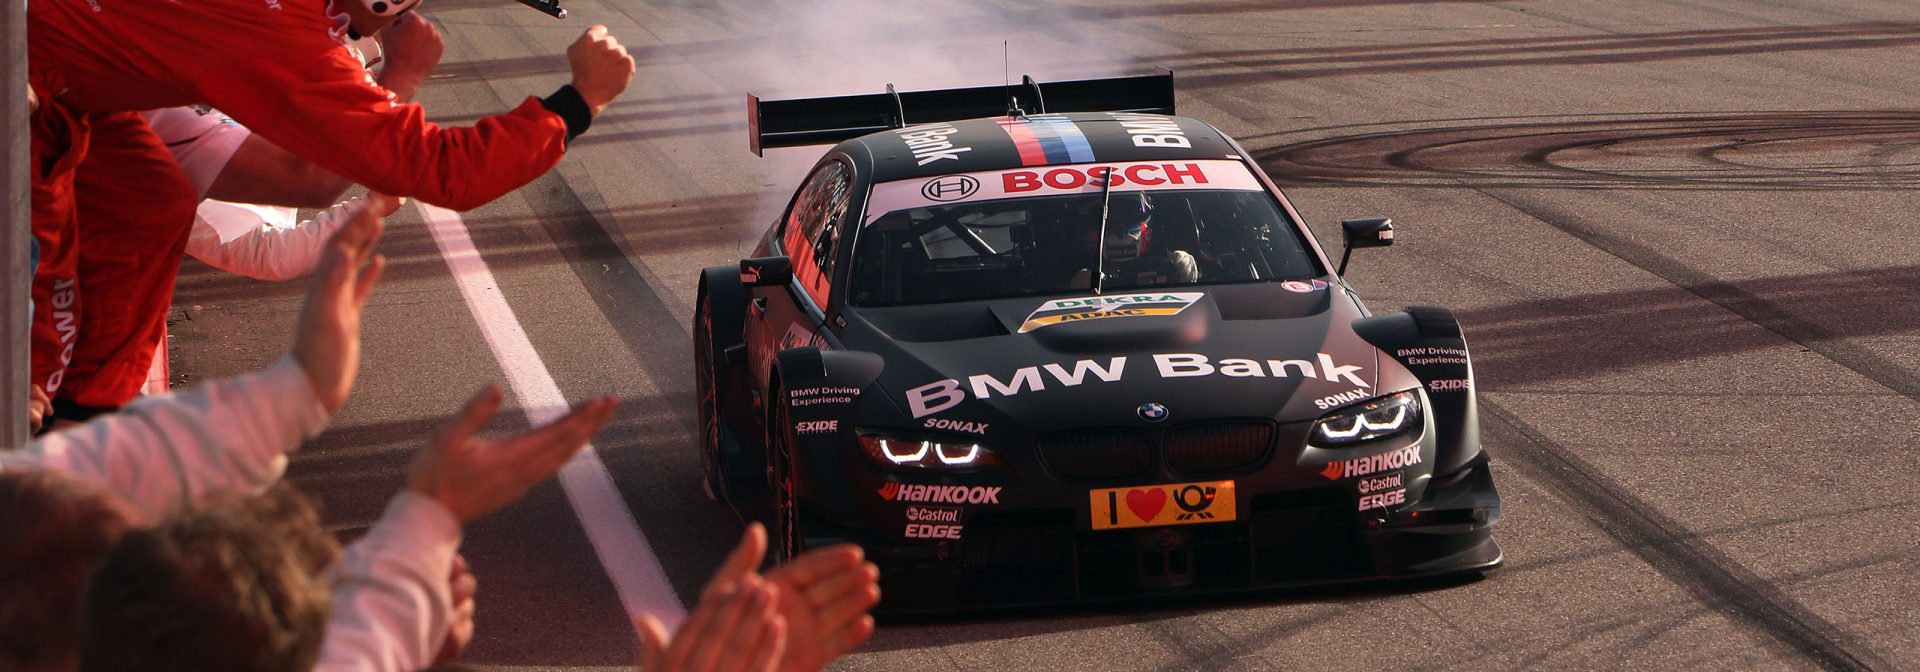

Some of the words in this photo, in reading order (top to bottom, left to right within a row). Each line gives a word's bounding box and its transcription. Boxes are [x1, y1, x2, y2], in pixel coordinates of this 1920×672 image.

[1001, 163, 1209, 193] BOSCH
[1055, 295, 1185, 308] DEKRA
[1397, 347, 1426, 357] BMW
[1428, 347, 1466, 356] Driving
[1408, 356, 1467, 365] Experience
[905, 356, 1127, 419] BMW
[1152, 353, 1371, 388] Bank
[1429, 379, 1470, 390] EXIDE
[790, 388, 819, 397] BMW
[822, 386, 860, 395] Driving
[791, 396, 851, 406] Experience
[1314, 388, 1371, 410] SONAX
[795, 420, 838, 432] EXIDE
[923, 418, 989, 435] SONAX
[1370, 474, 1401, 492] Castrol
[1358, 488, 1407, 511] EDGE
[918, 508, 958, 521] Castrol
[904, 523, 963, 539] EDGE
